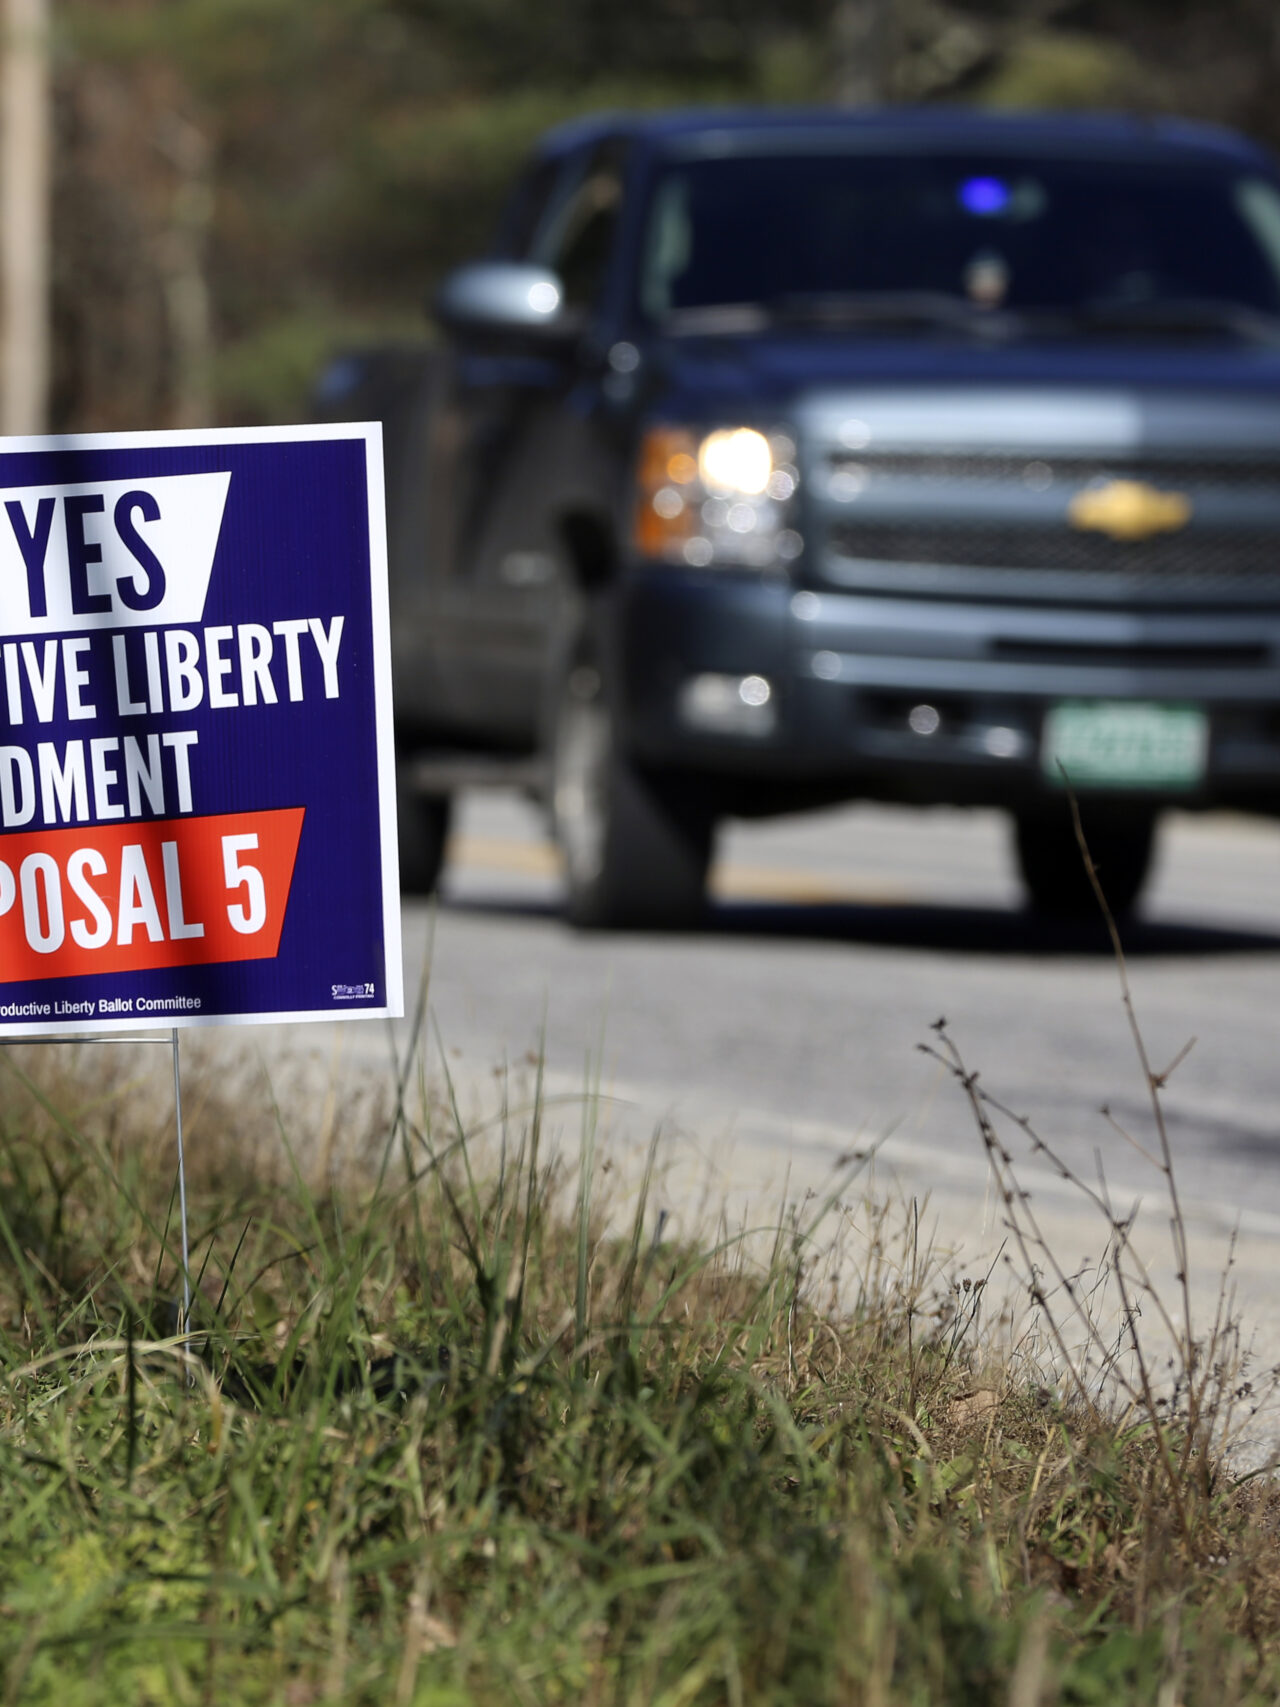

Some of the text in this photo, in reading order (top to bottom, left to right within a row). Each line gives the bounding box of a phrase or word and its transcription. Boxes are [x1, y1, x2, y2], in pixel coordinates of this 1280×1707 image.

[5, 490, 167, 618] YES
[112, 616, 345, 717] LIBERTY
[221, 833, 267, 935] 5
[54, 1000, 95, 1016] Liberty
[99, 998, 133, 1013] Ballot
[136, 995, 201, 1012] Committee
